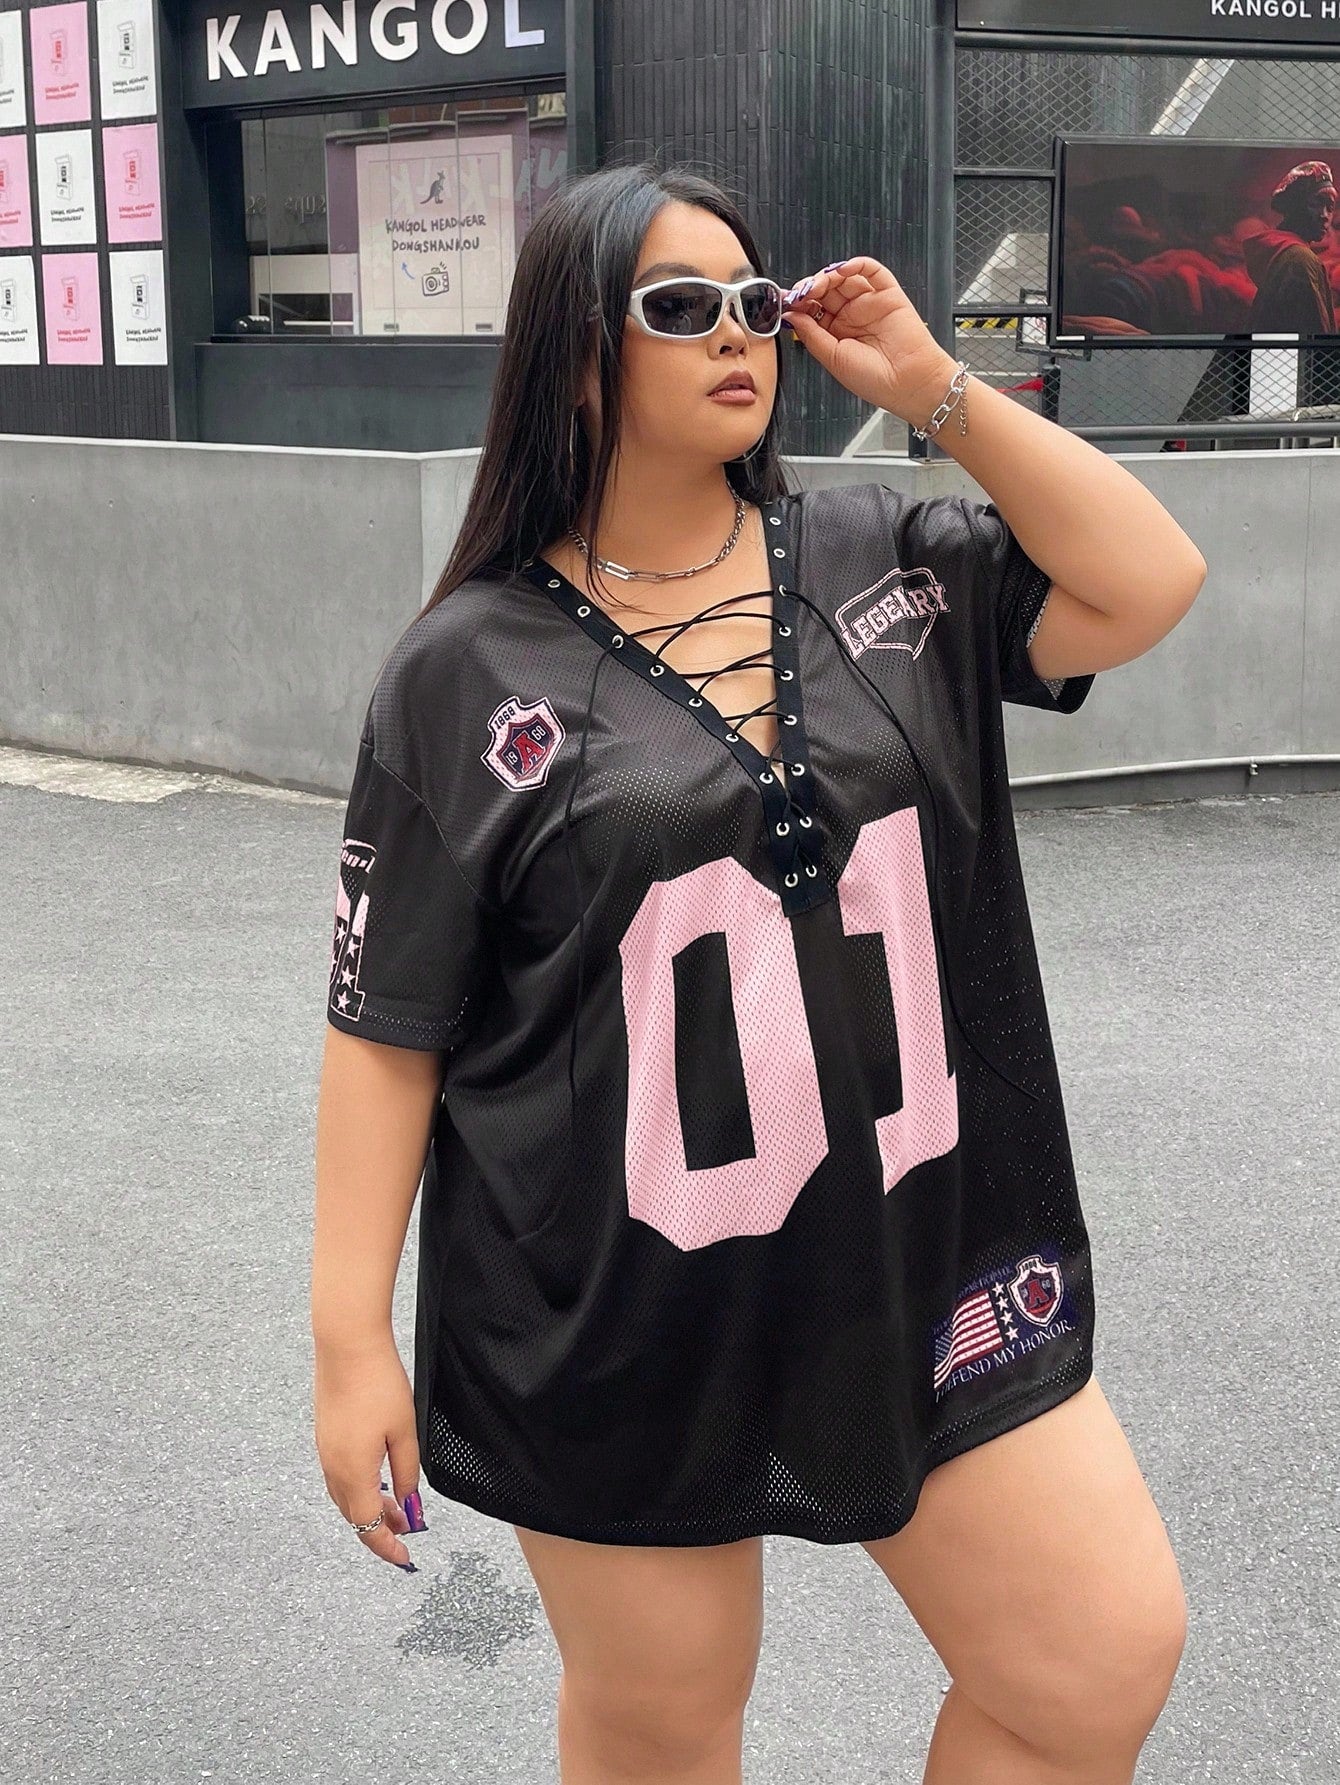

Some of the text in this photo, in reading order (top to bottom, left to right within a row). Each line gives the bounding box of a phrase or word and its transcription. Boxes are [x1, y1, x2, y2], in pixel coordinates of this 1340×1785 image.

[1211, 0, 1340, 19] KANGOL H
[206, 0, 545, 81] KANGOL
[385, 214, 486, 235] KANGOL HEADWEAR
[392, 237, 480, 253] DONGSHANKOU
[512, 730, 545, 774] A
[618, 806, 959, 1252] 01
[1027, 1279, 1049, 1308] A
[993, 1343, 1016, 1368] MY
[1020, 1320, 1076, 1354] HONOR.
